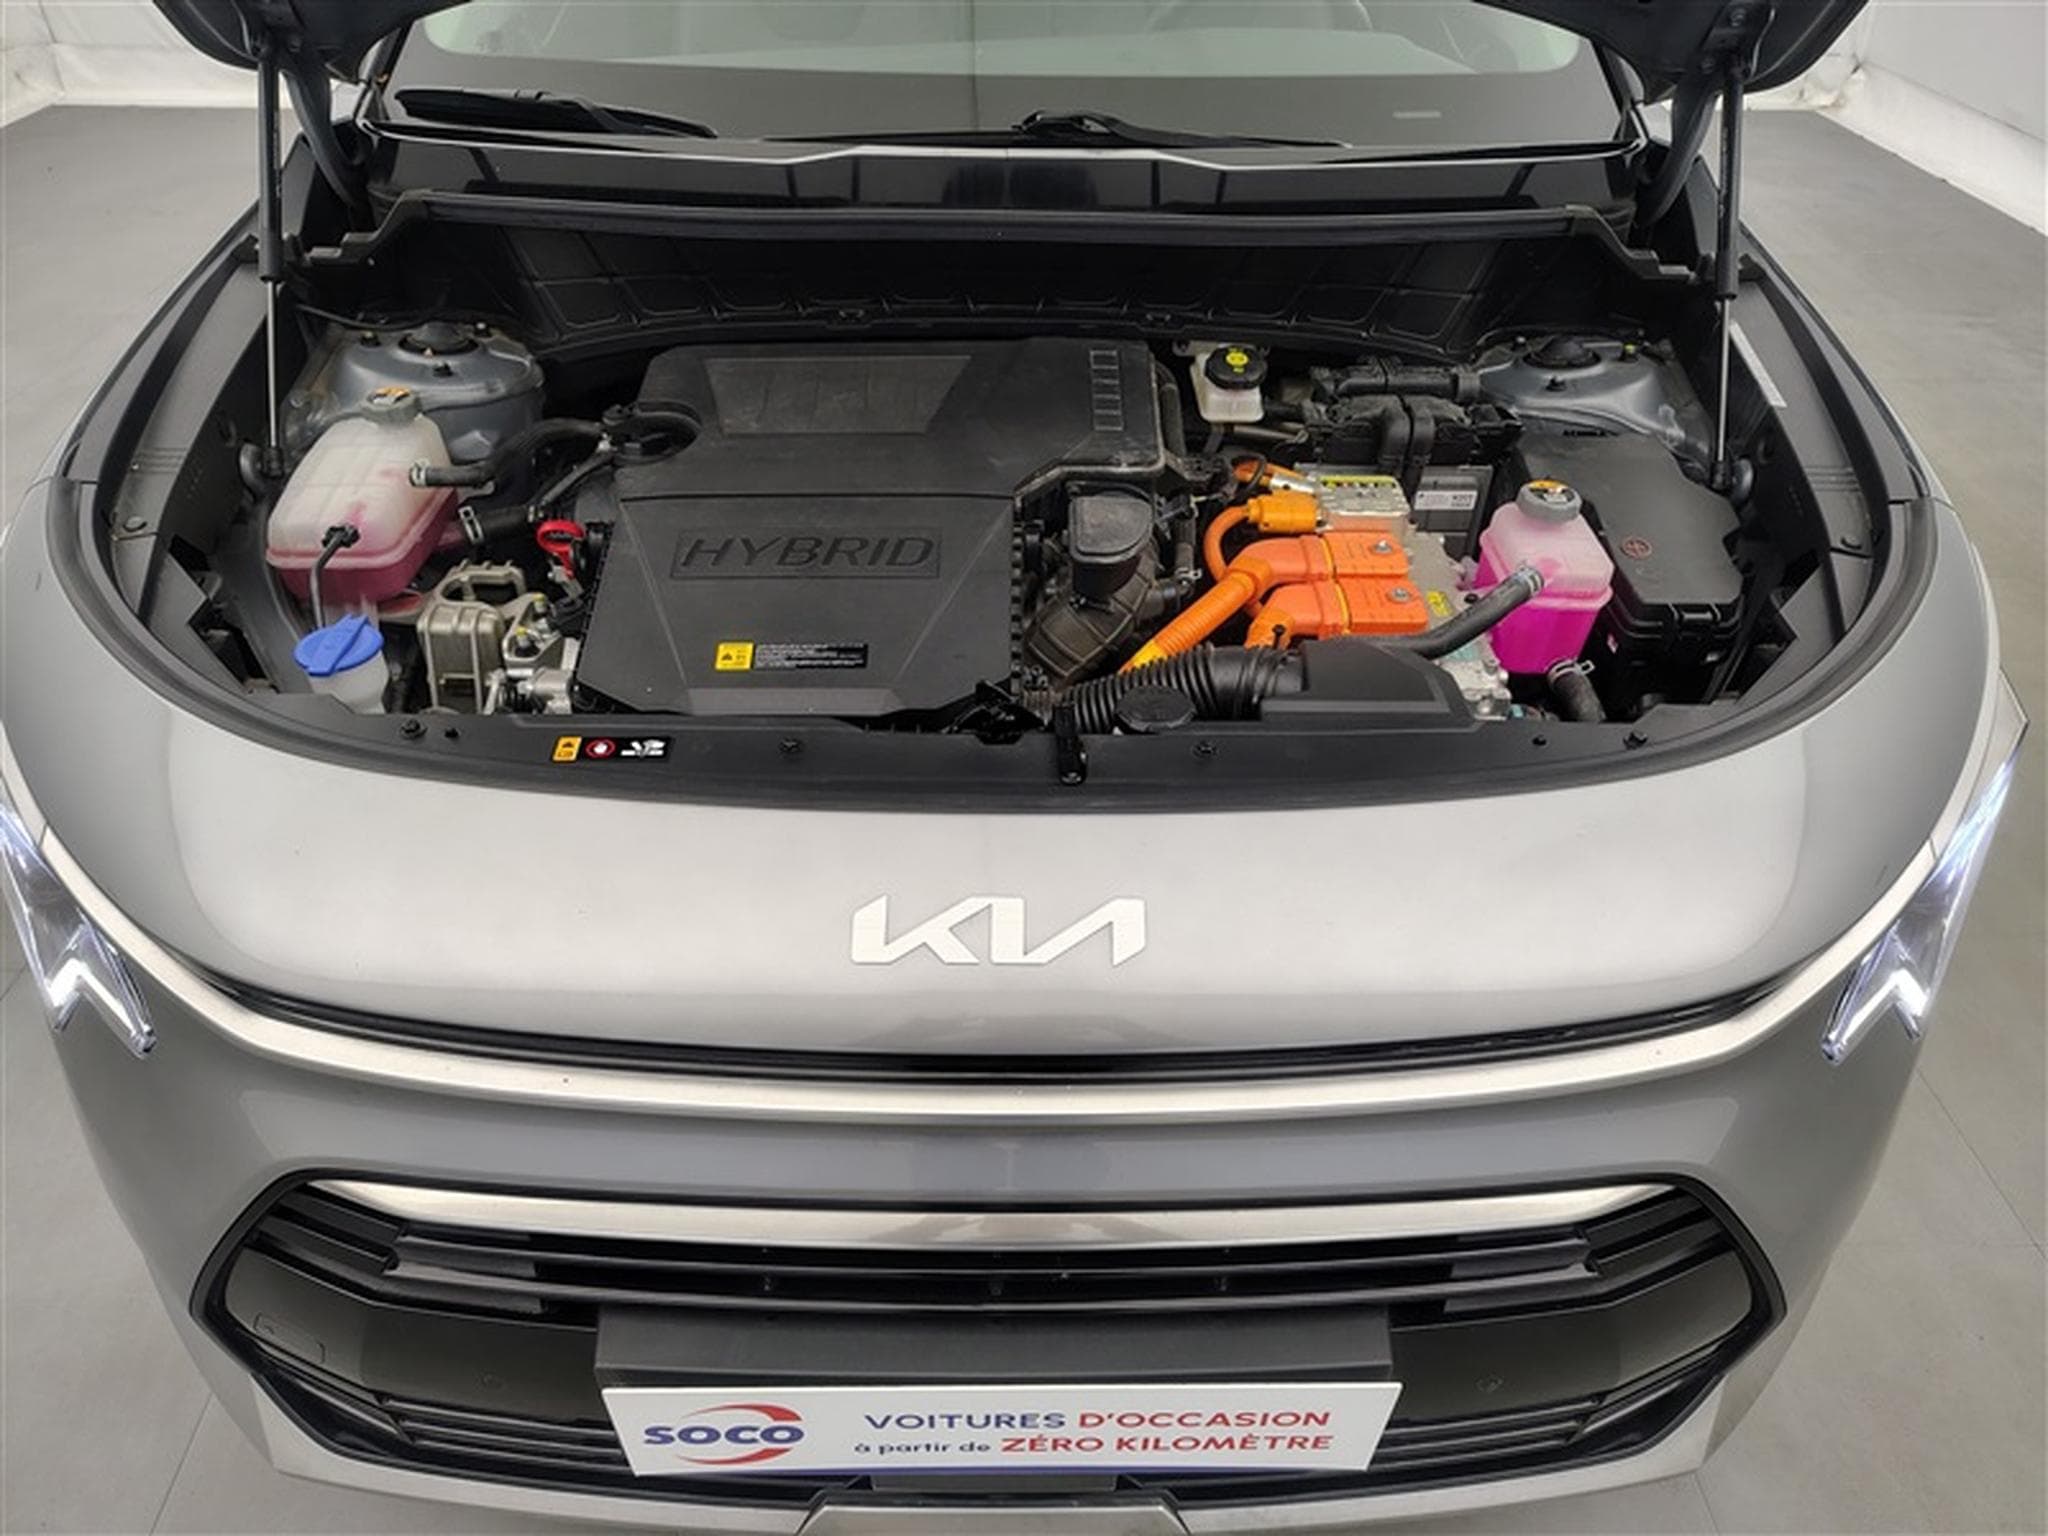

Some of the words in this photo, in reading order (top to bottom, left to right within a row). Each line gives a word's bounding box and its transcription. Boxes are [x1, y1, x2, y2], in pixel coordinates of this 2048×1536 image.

[680, 536, 935, 567] HYBRID
[850, 894, 1147, 967] KIA
[864, 1413, 1067, 1430] VOITURES
[1078, 1411, 1332, 1429] D'OCCASION
[643, 1424, 805, 1446] SOCO
[878, 1442, 951, 1456] partir
[958, 1440, 992, 1453] de
[1001, 1433, 1104, 1453] ZÉRO
[1115, 1433, 1335, 1451] KILOMÈTRE
